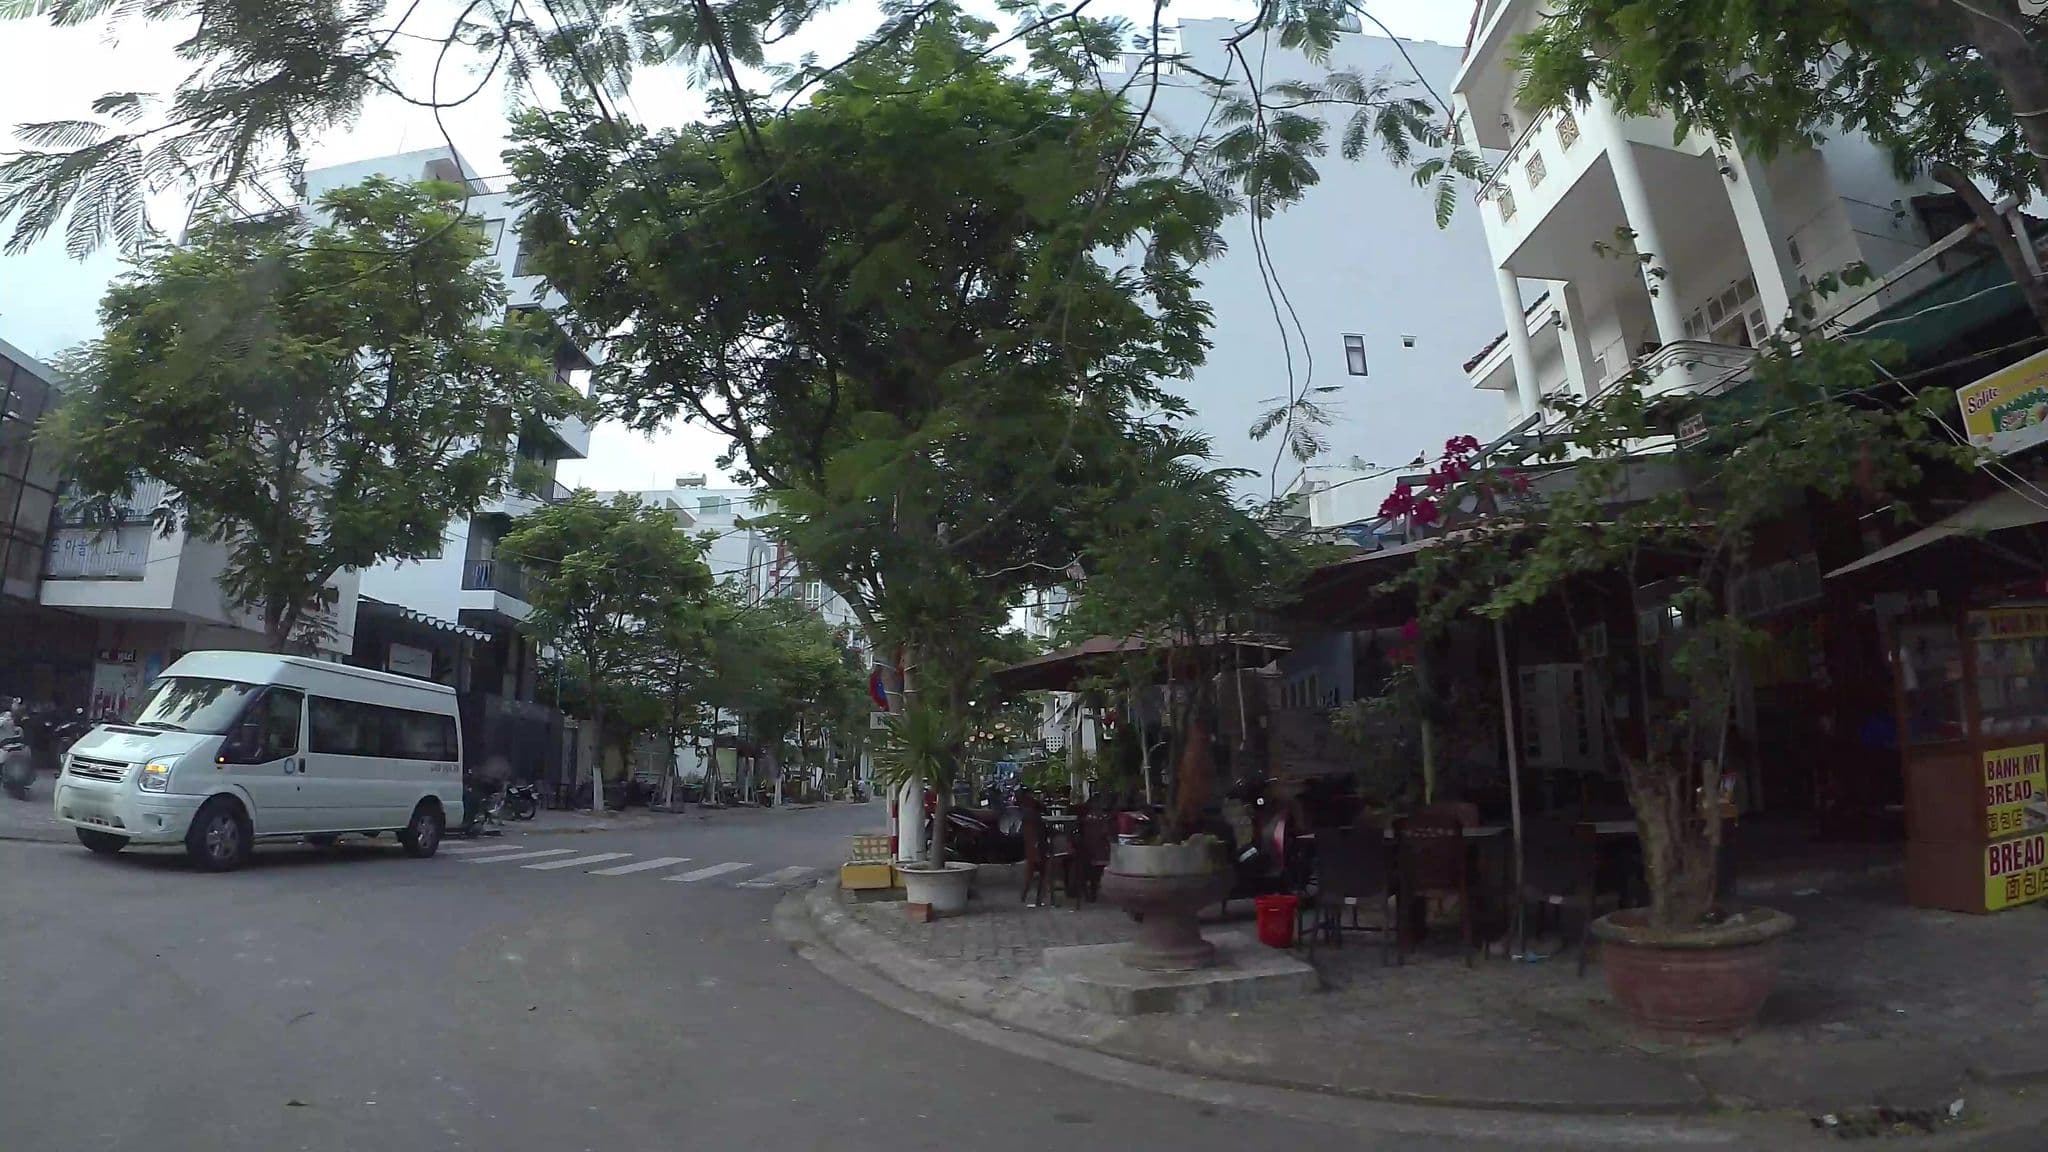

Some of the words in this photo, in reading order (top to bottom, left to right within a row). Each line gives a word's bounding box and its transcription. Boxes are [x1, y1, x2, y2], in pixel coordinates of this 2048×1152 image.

[1987, 755, 2020, 781] BÁNH
[1985, 780, 2032, 806] BREAD
[1989, 835, 2044, 877] BREAD
